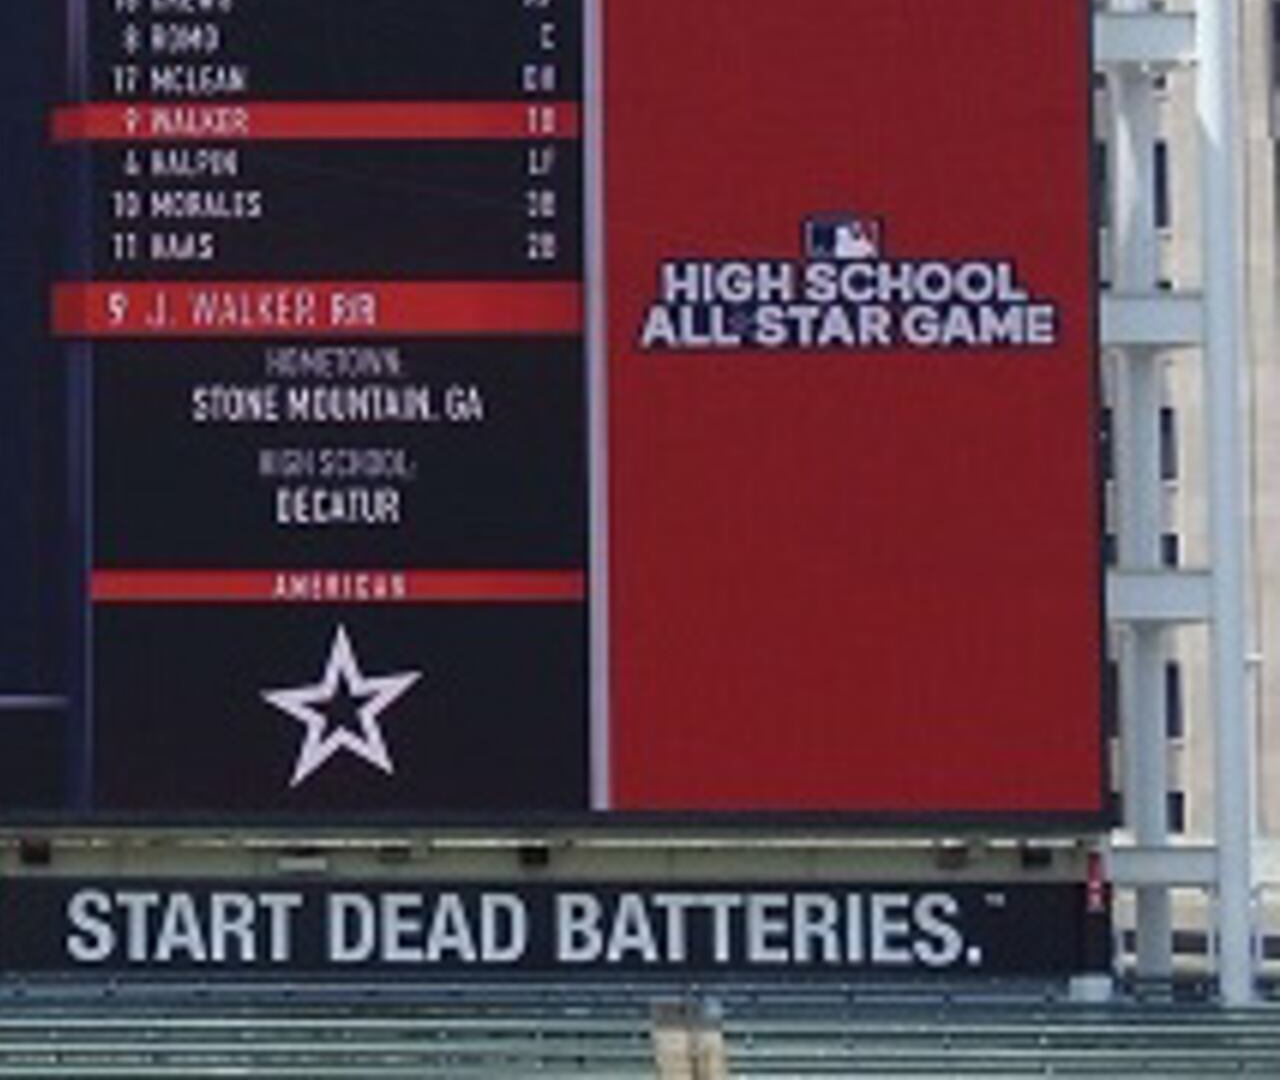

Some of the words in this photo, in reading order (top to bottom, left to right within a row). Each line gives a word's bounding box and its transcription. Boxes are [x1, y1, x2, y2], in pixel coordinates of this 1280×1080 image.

[541, 23, 555, 49] C
[151, 107, 248, 135] WALKER
[151, 191, 261, 218] MORALES
[662, 262, 792, 302] HIGH
[805, 261, 1027, 301] SCHOOL
[107, 291, 128, 326] 9
[190, 290, 315, 326] WALKER
[901, 304, 1055, 344] GAME
[192, 385, 278, 422] STONE
[445, 384, 483, 422] GA
[259, 448, 313, 477] HIGH
[277, 488, 401, 523] DECATUR
[272, 573, 406, 600] AMERICAN
[66, 892, 301, 964] START
[327, 892, 527, 963] DEAD
